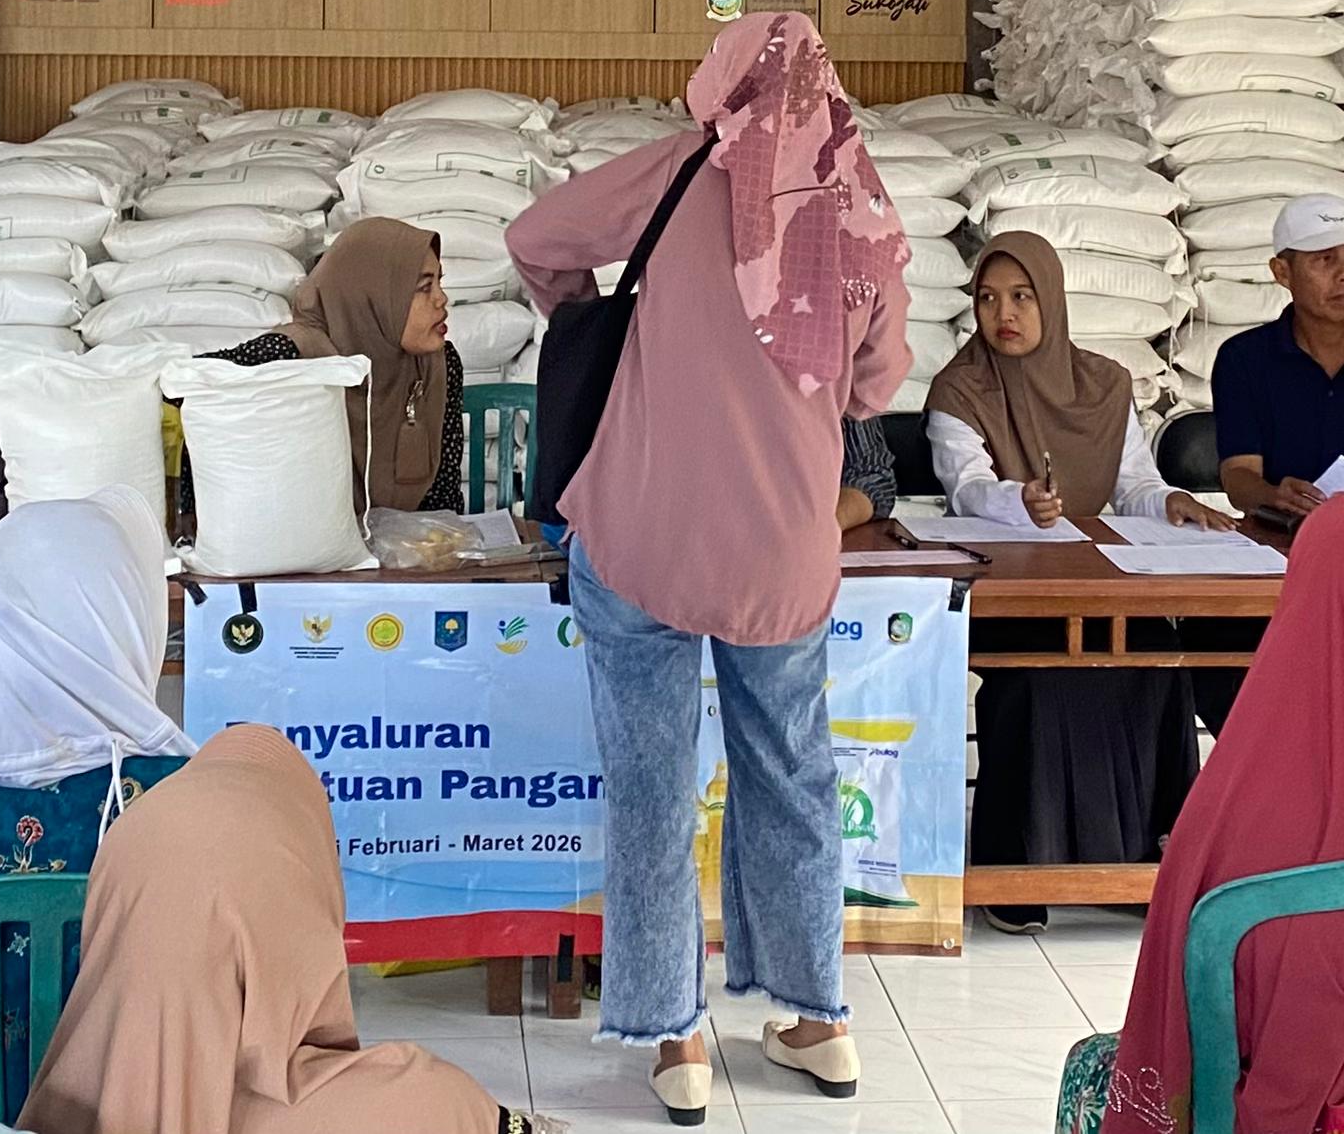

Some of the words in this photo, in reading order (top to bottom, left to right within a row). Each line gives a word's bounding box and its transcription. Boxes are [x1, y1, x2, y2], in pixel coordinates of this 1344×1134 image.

[830, 617, 863, 641] log
[226, 716, 490, 759] nyaluran
[322, 770, 423, 803] tuan
[348, 835, 440, 857] Februari
[463, 835, 524, 853] Maret
[531, 834, 582, 853] 2026
